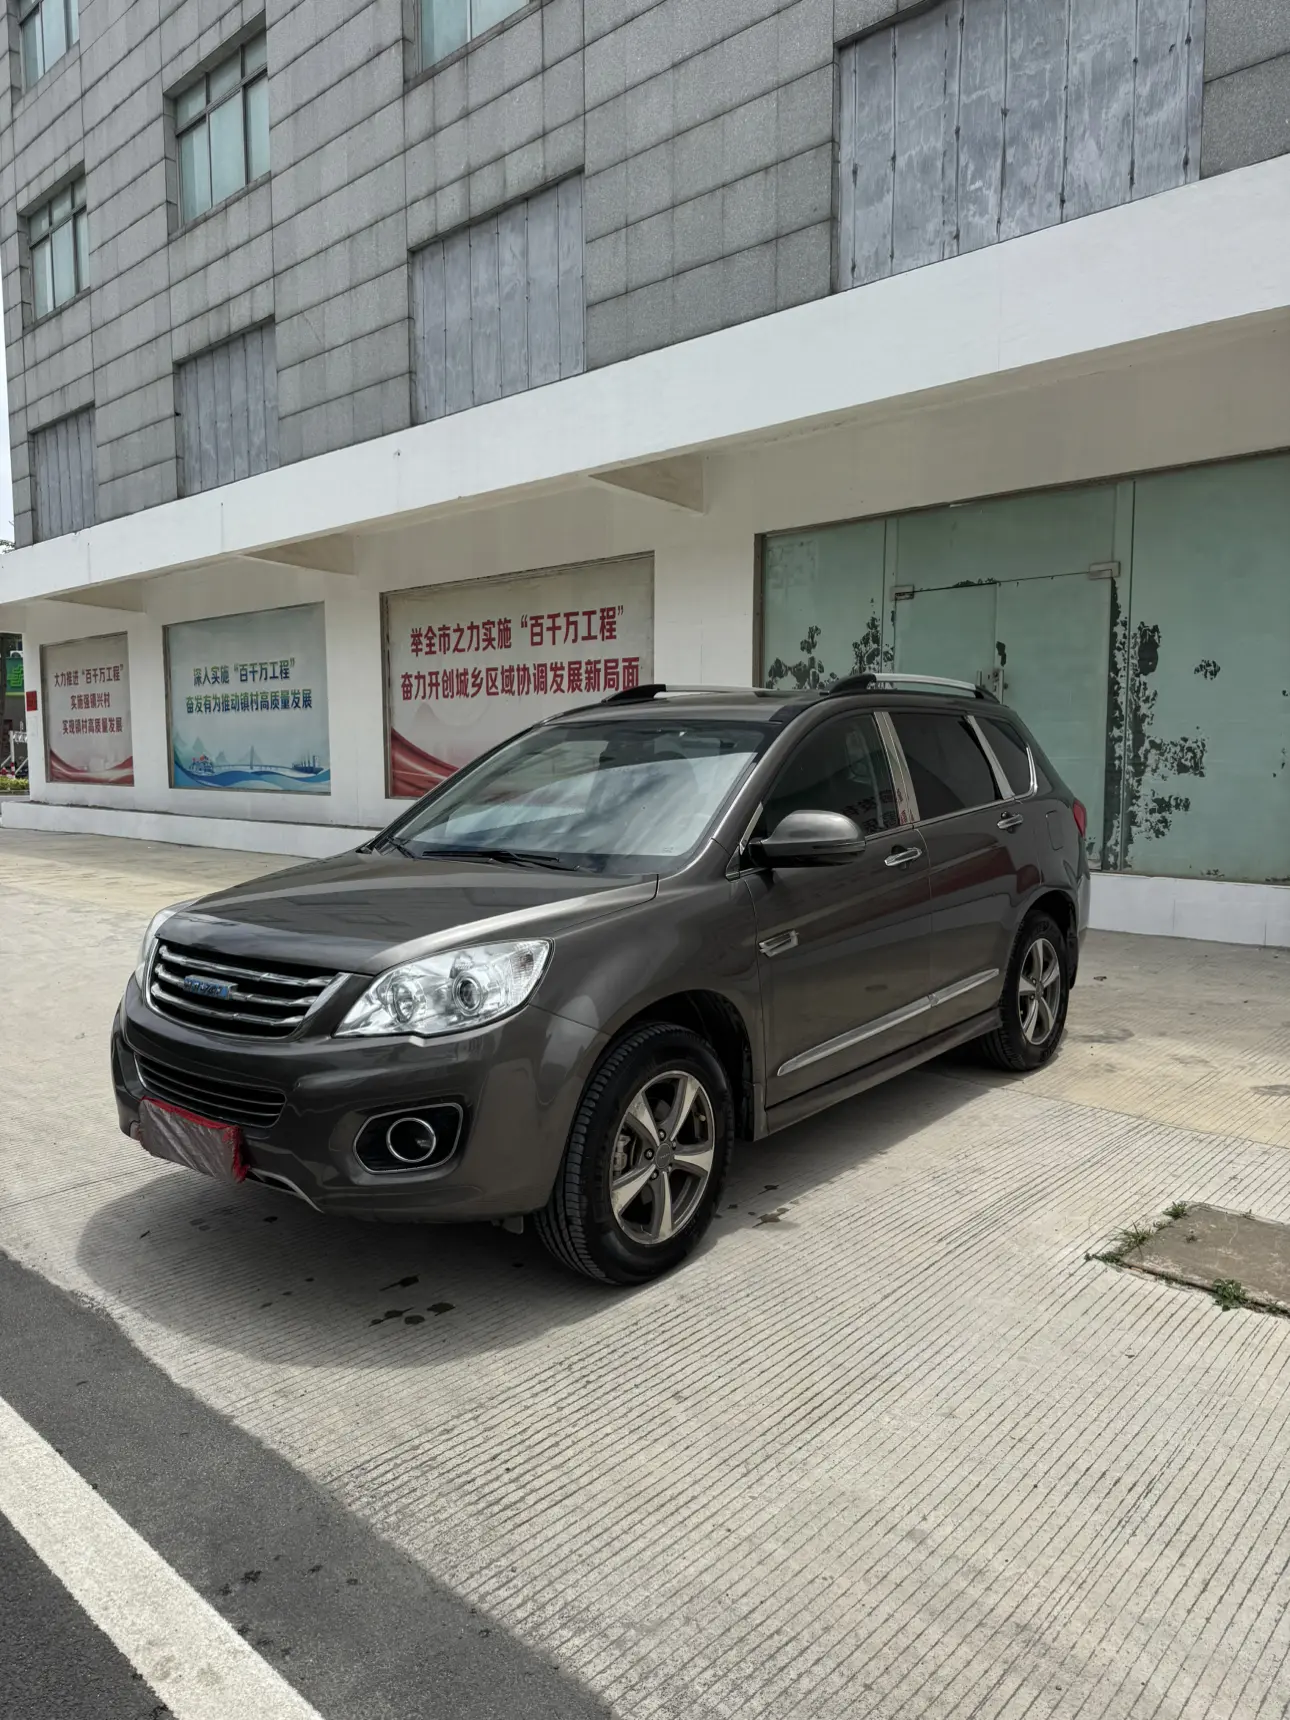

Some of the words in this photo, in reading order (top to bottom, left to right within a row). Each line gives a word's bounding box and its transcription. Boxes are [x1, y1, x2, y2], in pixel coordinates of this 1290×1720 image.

[410, 605, 624, 657] 举全市之力实施“百千万工程”
[401, 657, 640, 700] 奋力开创城乡区域协调发展新局面
[186, 688, 312, 714] 奋发有为推动镇村高质量发展
